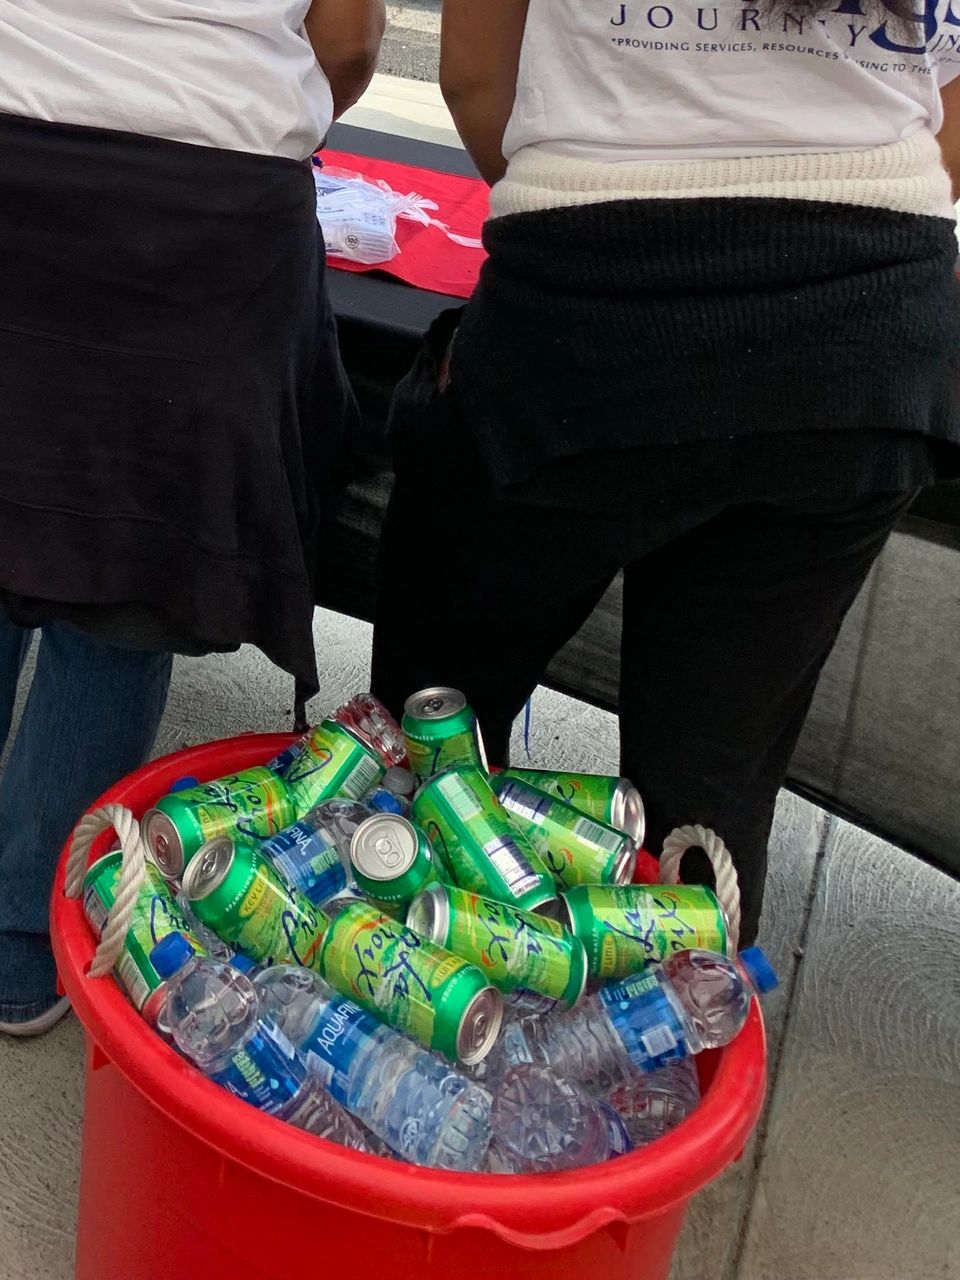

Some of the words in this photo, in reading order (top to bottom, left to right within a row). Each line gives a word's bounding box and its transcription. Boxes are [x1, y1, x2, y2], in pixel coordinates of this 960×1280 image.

[610, 4, 867, 47] JOURNY
[695, 42, 757, 53] SERVICES,
[762, 42, 839, 61] RESOURCES
[855, 60, 889, 73] SING
[893, 63, 907, 73] TO
[243, 892, 258, 912] KEY
